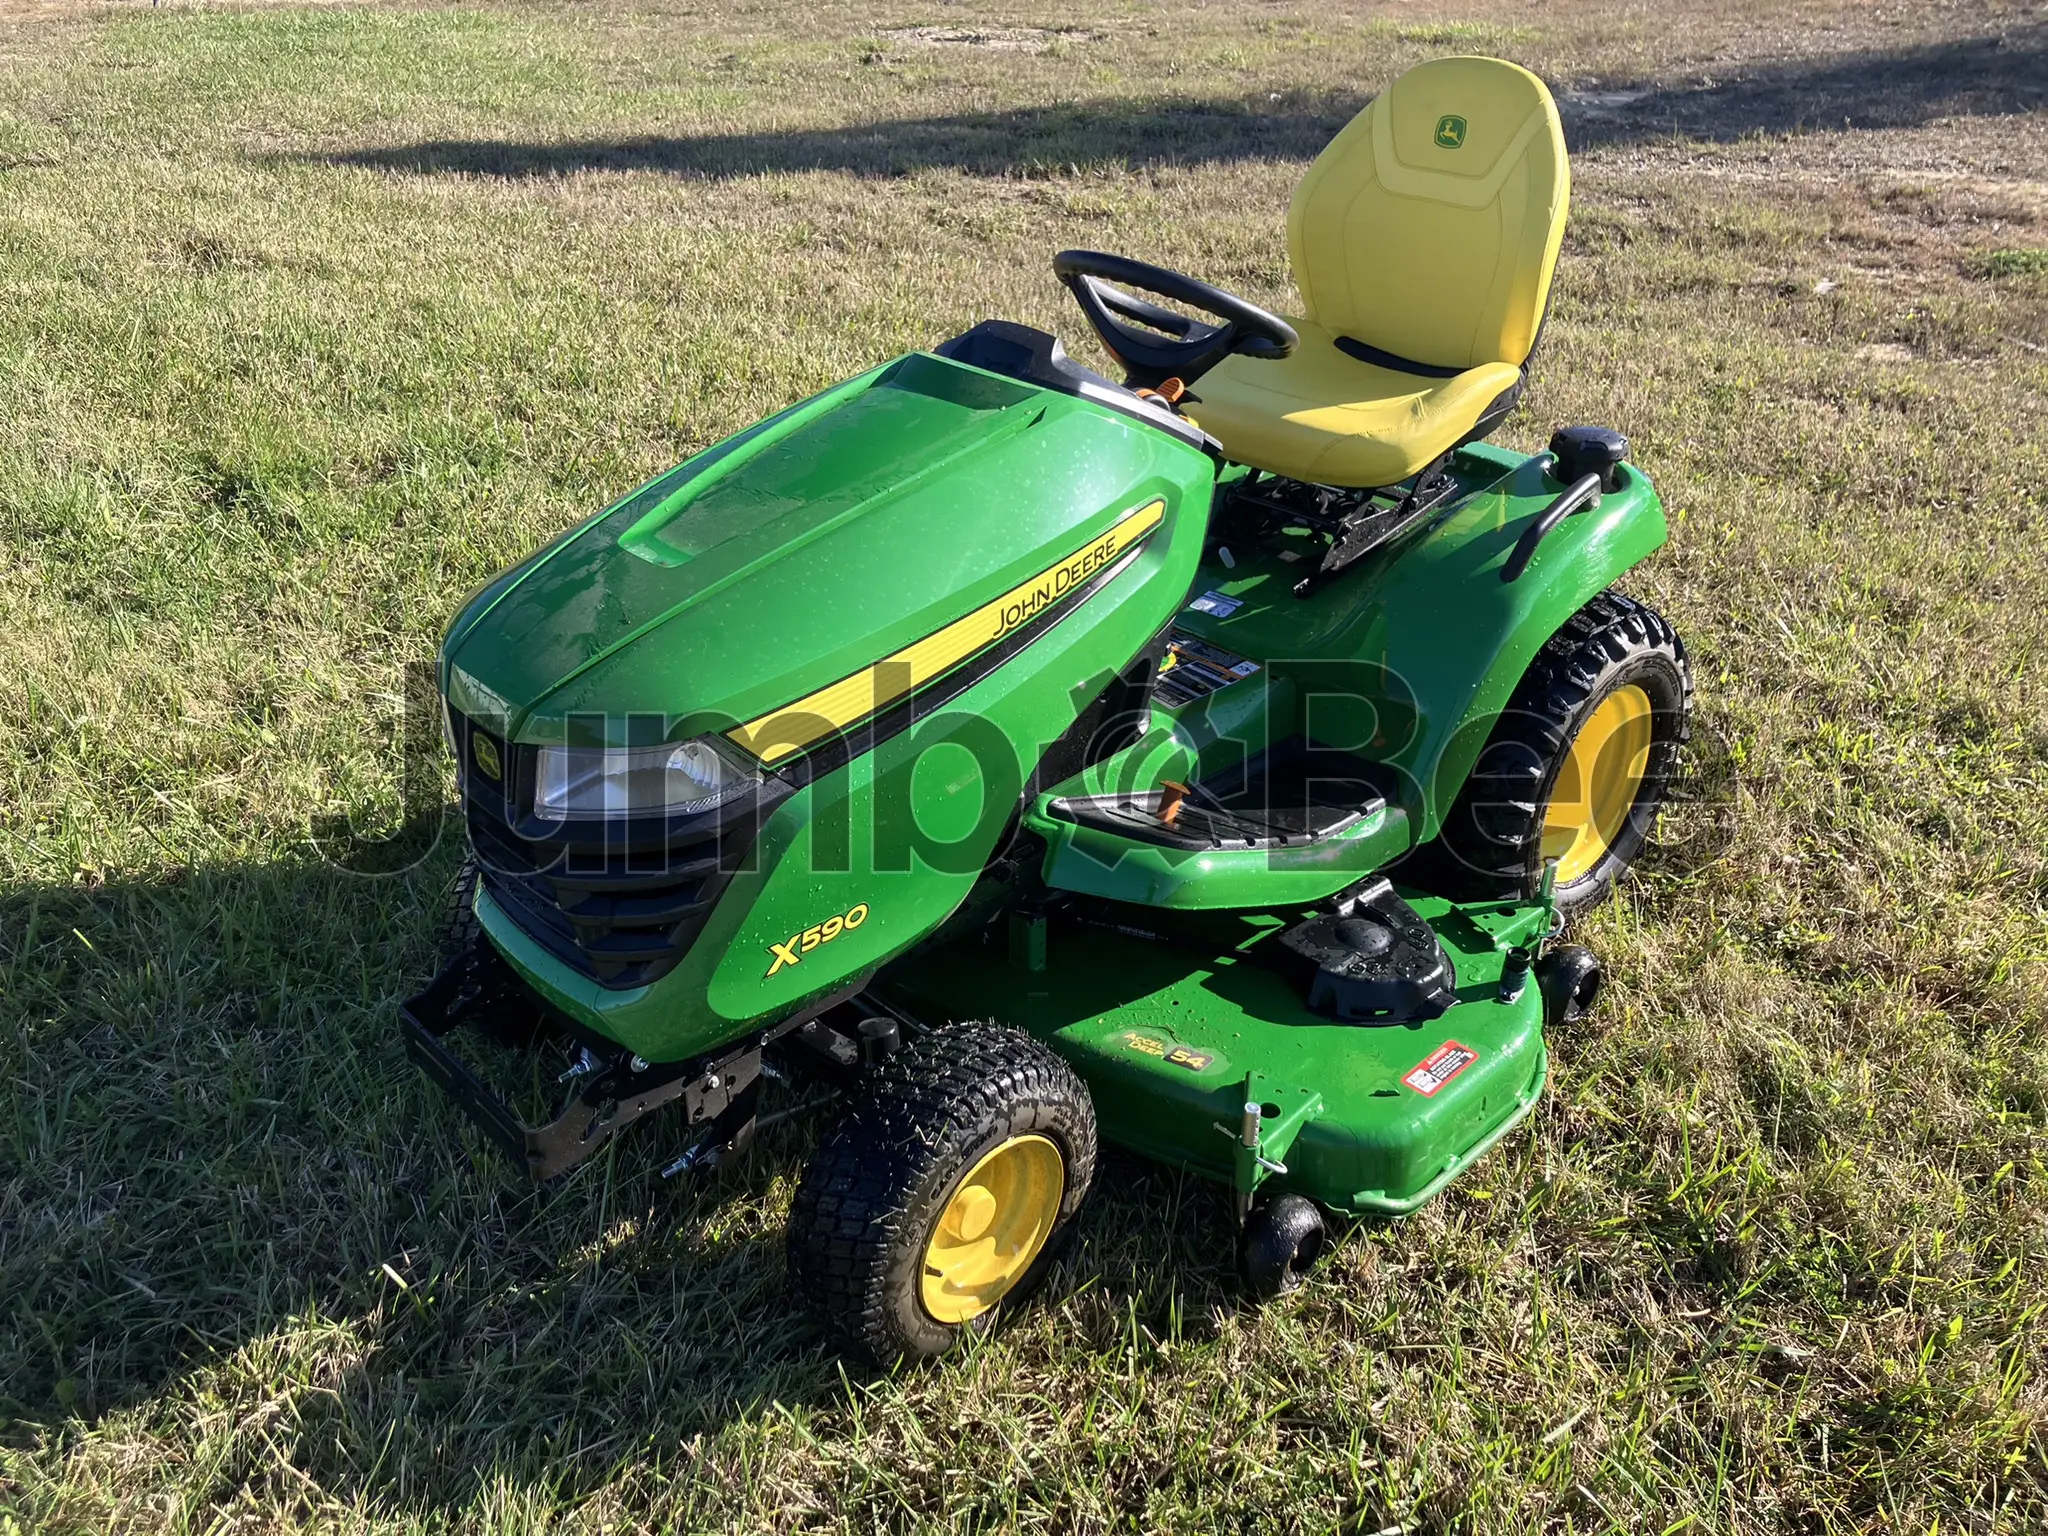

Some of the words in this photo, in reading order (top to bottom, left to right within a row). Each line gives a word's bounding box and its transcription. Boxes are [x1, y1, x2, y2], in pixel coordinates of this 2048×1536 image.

[993, 583, 1050, 636] JOHN
[1055, 535, 1116, 594] DEERE
[763, 902, 869, 979] X590
[1124, 1033, 1165, 1050] ACCEL
[1128, 1041, 1165, 1056] DEEP
[1170, 1049, 1205, 1068] 54
